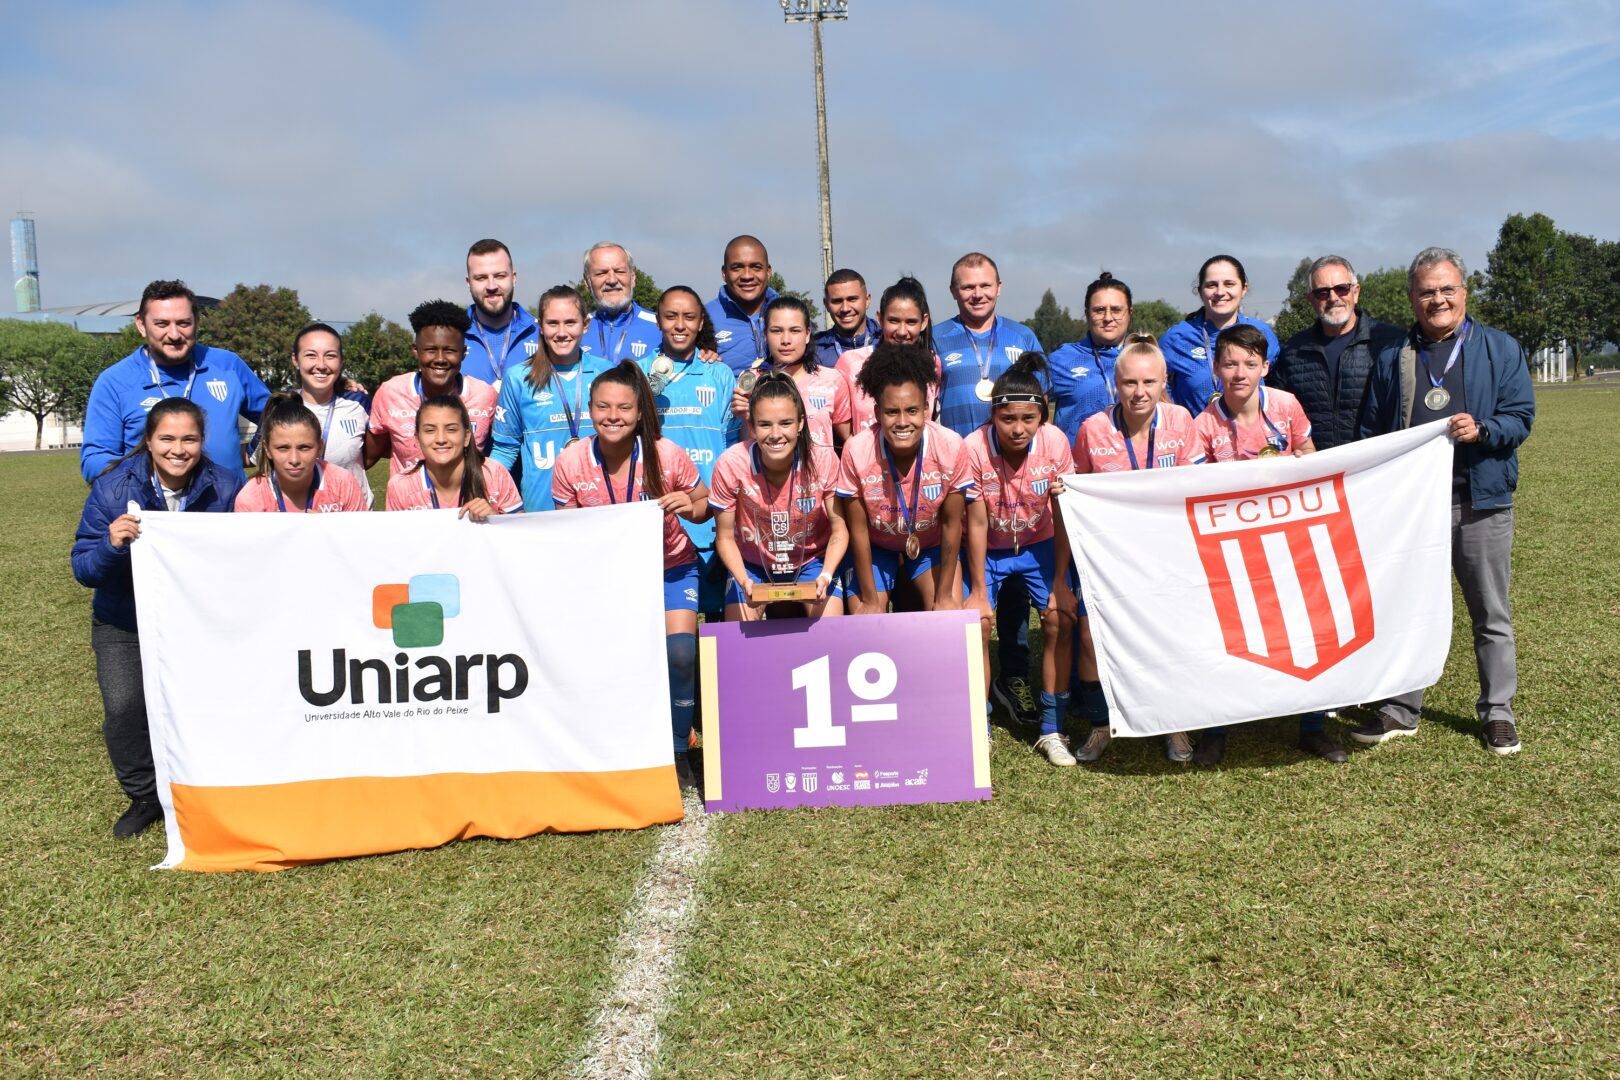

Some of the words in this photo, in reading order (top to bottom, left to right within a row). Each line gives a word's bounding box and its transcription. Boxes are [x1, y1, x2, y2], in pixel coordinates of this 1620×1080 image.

[1156, 438, 1185, 450] WOA
[685, 447, 714, 465] iarp
[1208, 486, 1324, 528] FCDU
[773, 513, 787, 523] JU
[773, 522, 787, 532] CS
[298, 648, 529, 714] Uniarp
[791, 652, 899, 748] 1º
[304, 710, 361, 723] Universidade
[363, 709, 381, 719] Alto
[382, 709, 401, 719] Vale
[403, 708, 415, 718] do
[416, 707, 431, 716] Rio
[433, 706, 443, 715] do
[446, 705, 469, 715] Peixe
